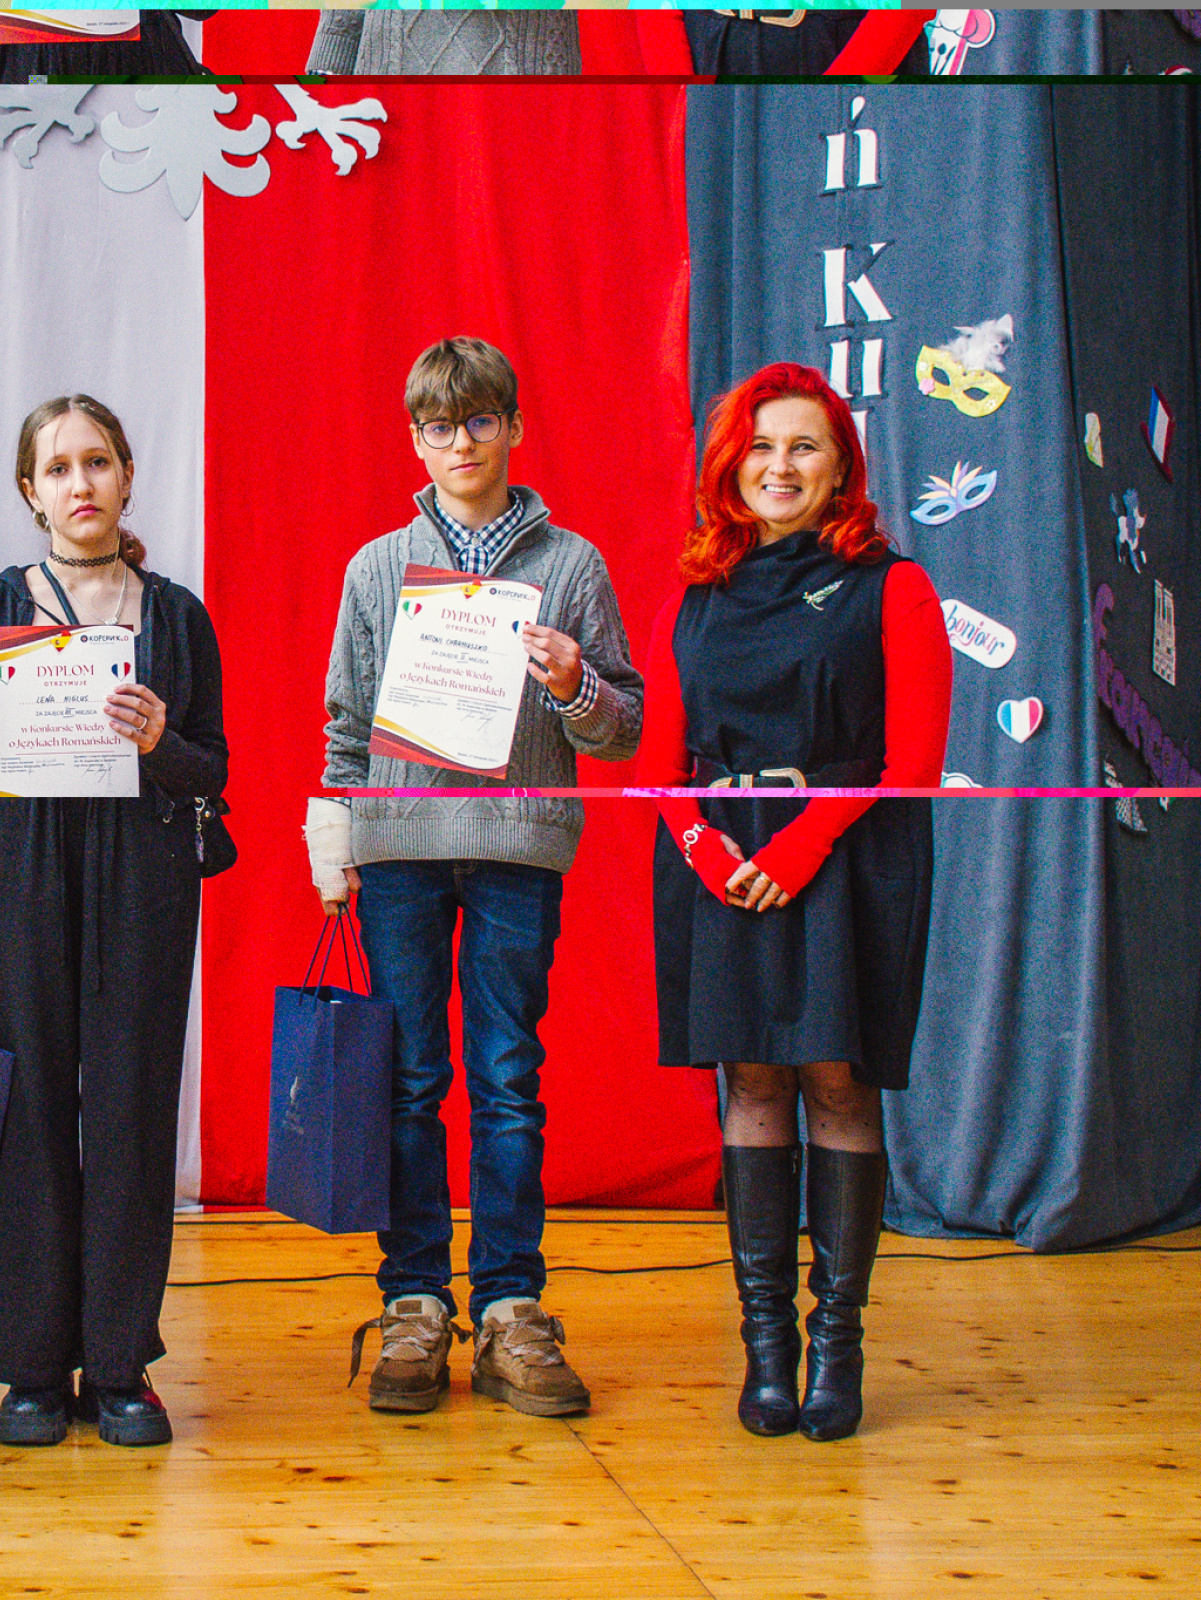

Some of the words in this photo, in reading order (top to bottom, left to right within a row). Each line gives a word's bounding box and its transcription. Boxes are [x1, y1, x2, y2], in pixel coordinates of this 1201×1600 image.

[441, 608, 497, 628] DYPLOM
[445, 624, 486, 636] OTRZYMUJE
[946, 603, 1005, 655] bonjour
[37, 664, 95, 677] DYPLOM
[422, 662, 464, 676] Konkursie
[465, 669, 493, 683] Wiedzy
[406, 672, 447, 688] Językach
[448, 680, 506, 697] Romańskich
[30, 724, 74, 734] Konkursie
[75, 722, 105, 733] Wiedzy
[16, 737, 60, 750] Językach
[61, 735, 121, 746] Romańskich
